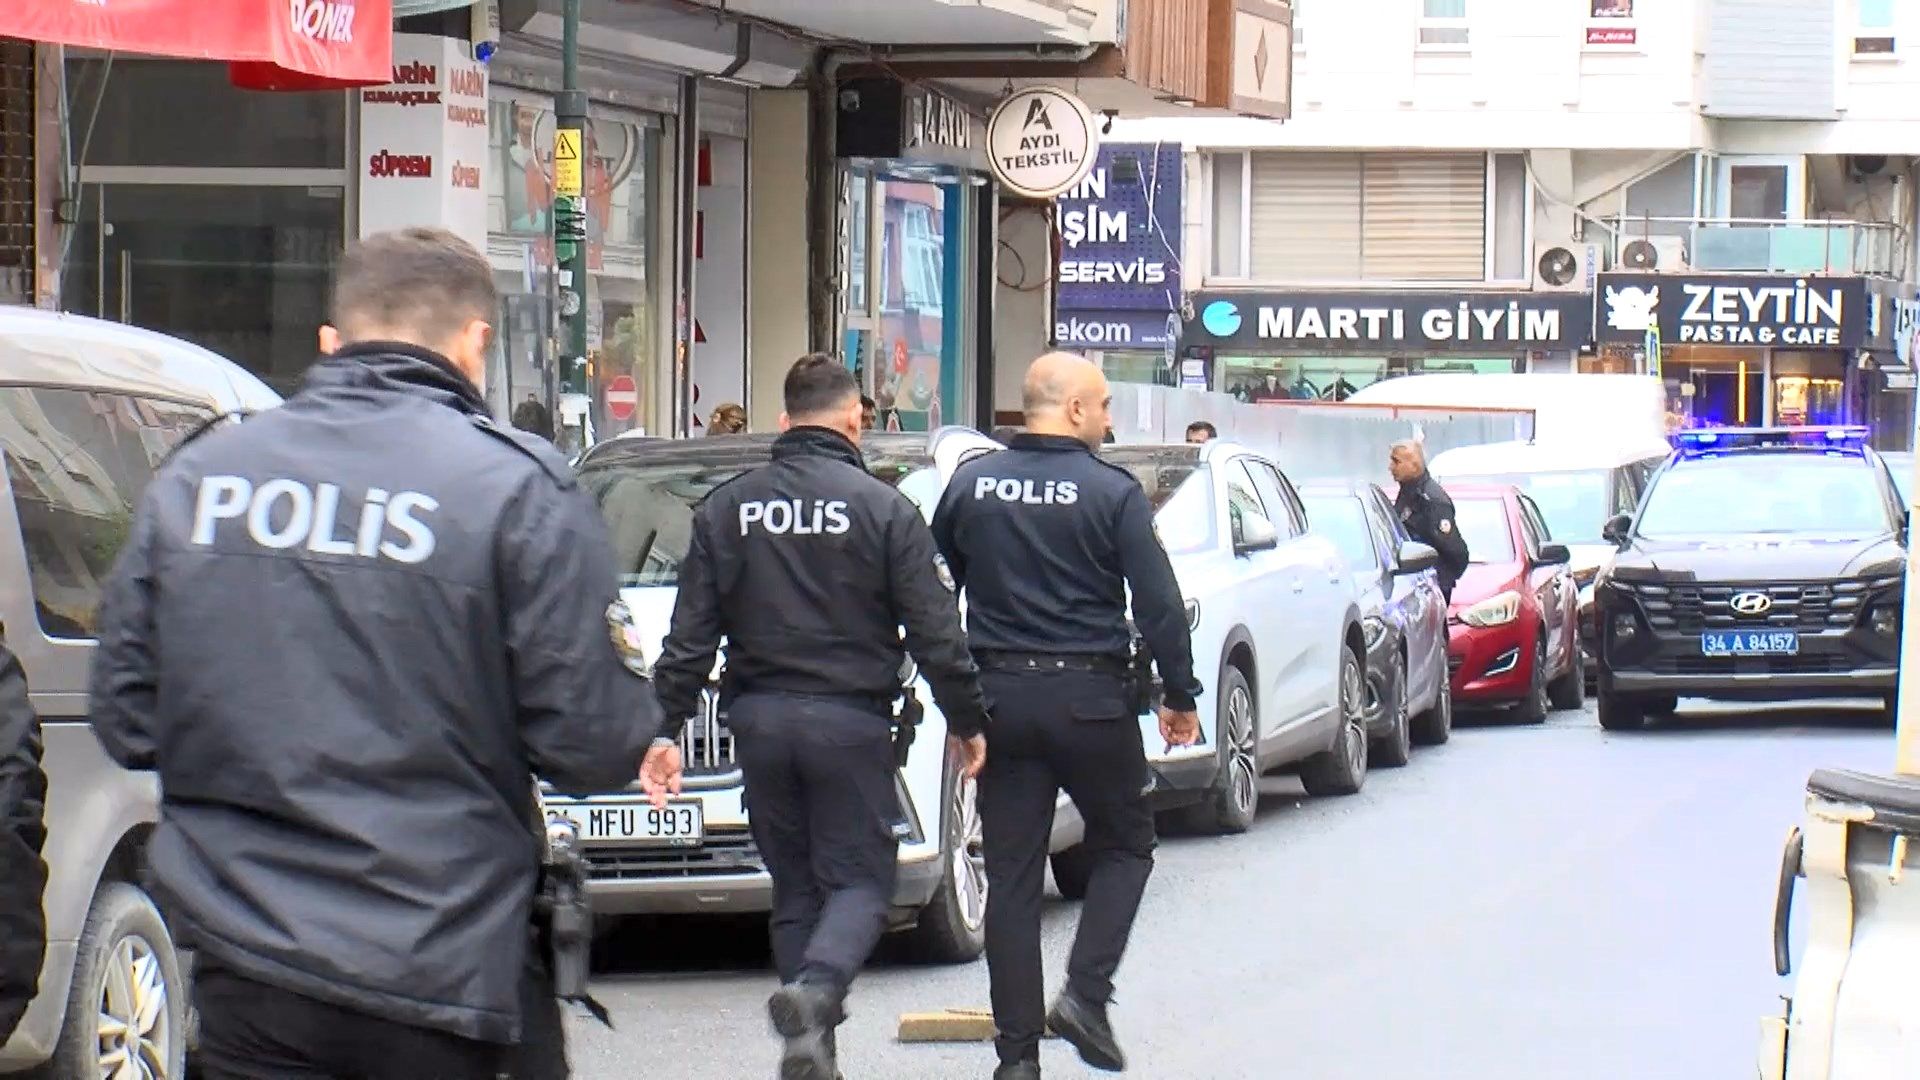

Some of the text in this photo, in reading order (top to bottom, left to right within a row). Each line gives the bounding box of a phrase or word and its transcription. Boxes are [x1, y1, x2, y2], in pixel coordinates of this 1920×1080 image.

[392, 61, 436, 84] ARİN
[1020, 134, 1060, 150] AYDI
[370, 149, 431, 177] SÜPREM
[1003, 148, 1079, 170] TEKSTİL
[1059, 257, 1165, 283] SERVİS
[1681, 279, 1842, 325] ZEYTİN
[1258, 301, 1560, 341] MARTI GİYİM
[1680, 325, 1841, 345] PASTA & CAFE
[1706, 633, 1794, 651] 34 A 84157
[590, 809, 692, 837] MFU 993
